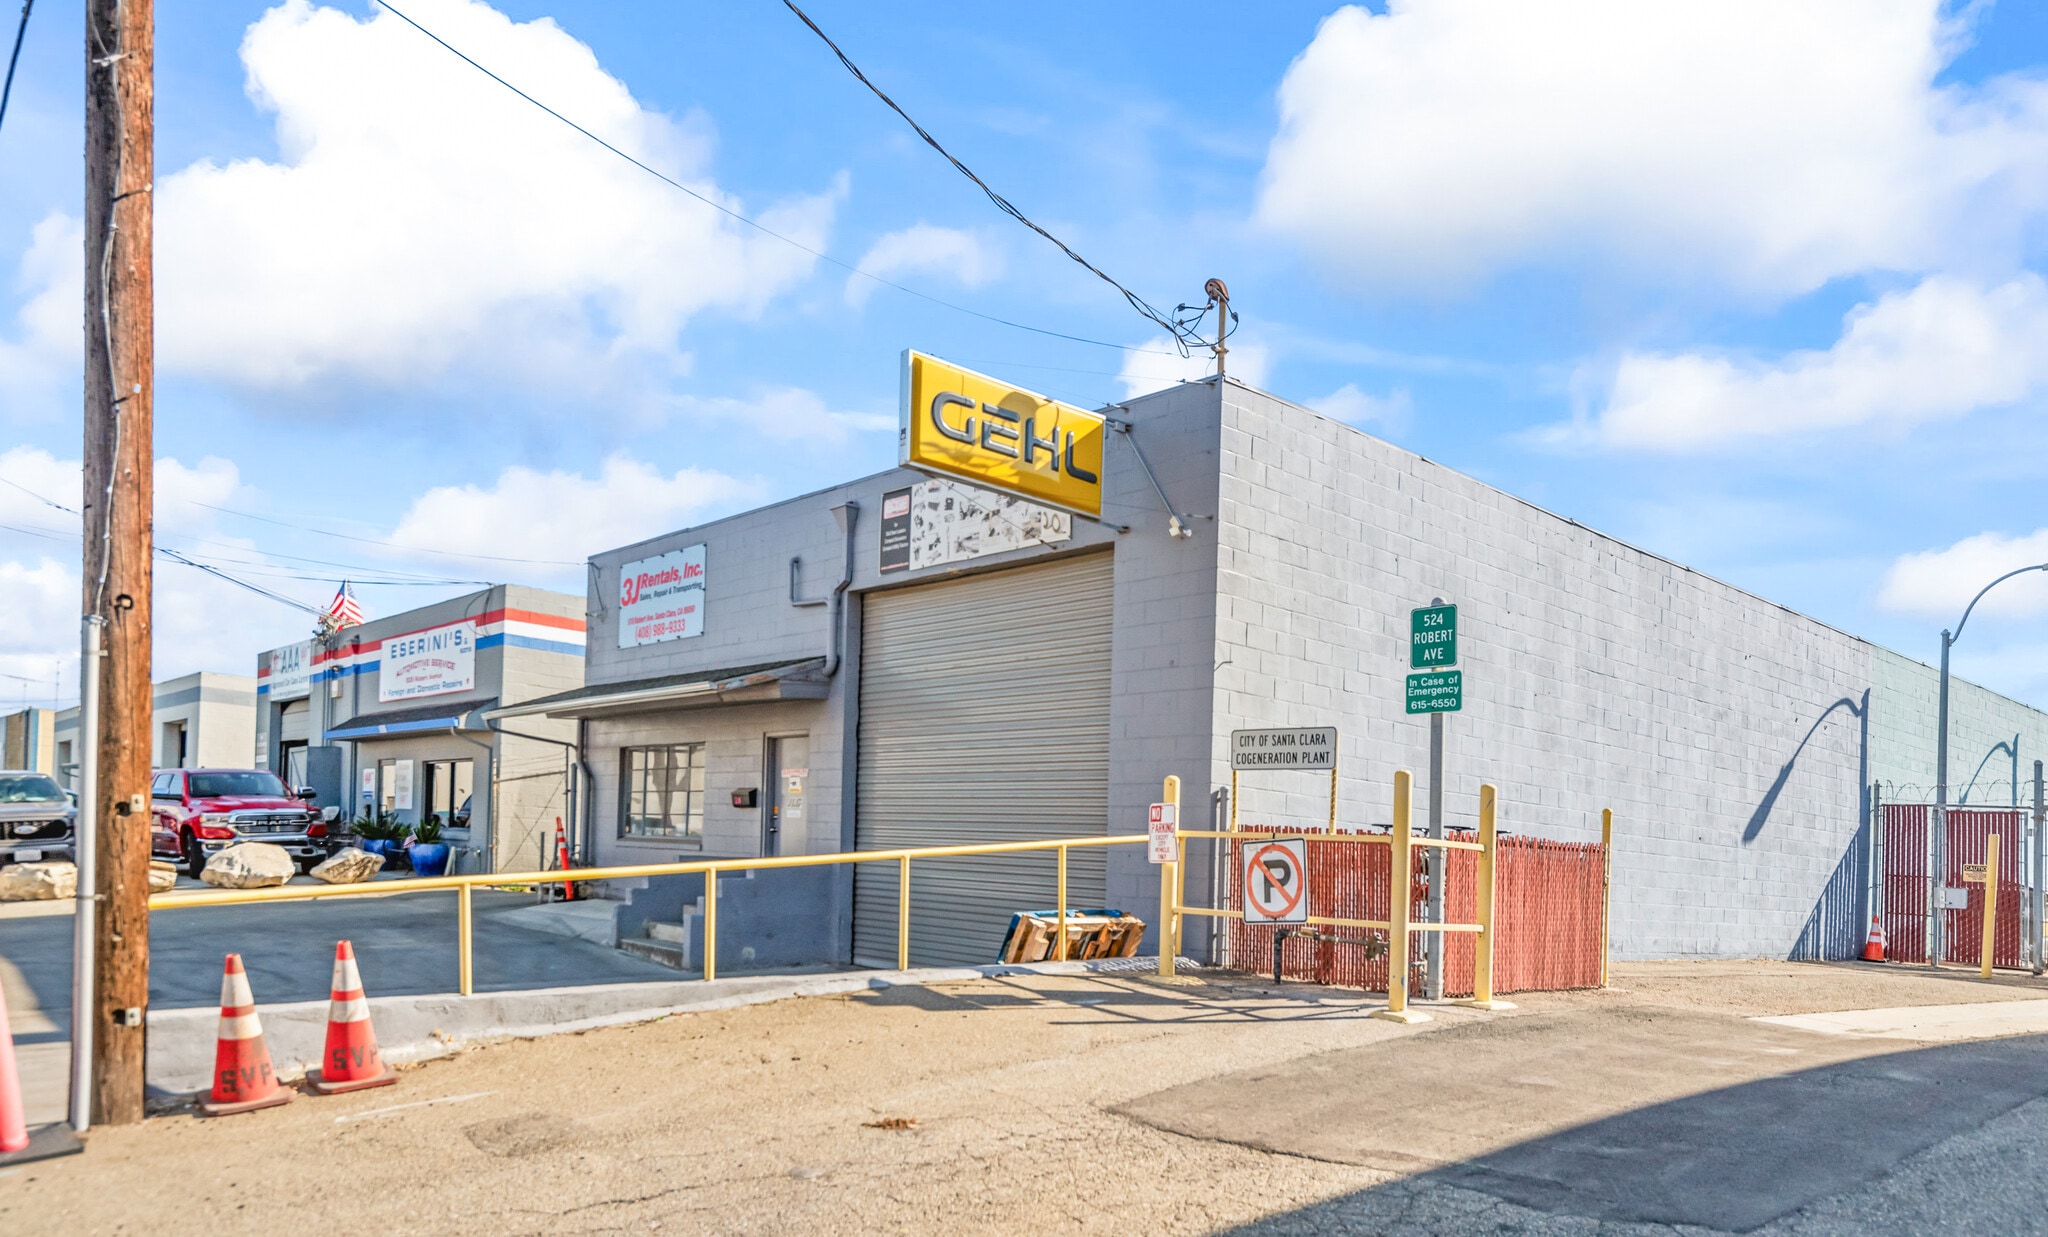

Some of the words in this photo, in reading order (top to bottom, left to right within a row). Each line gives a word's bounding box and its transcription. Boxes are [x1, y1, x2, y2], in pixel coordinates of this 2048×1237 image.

[931, 391, 1098, 485] GEHL
[640, 567, 681, 587] Rentals,
[684, 563, 703, 578] Inc.
[653, 588, 668, 598] Repair
[673, 582, 702, 593] Transporting
[1424, 613, 1443, 626] 524
[635, 623, 651, 641] (408)
[653, 619, 685, 636] 988-9333
[1414, 629, 1453, 644] ROBERT
[391, 629, 462, 659] ESERINI'S
[280, 646, 300, 673] AAA
[1423, 647, 1444, 661] AVE
[396, 659, 430, 677] AUTOMOTIVE
[431, 658, 456, 671] SERVICE
[417, 684, 441, 693] Domestic
[442, 680, 463, 688] Repairs
[1409, 679, 1417, 687] In
[1421, 677, 1444, 686] Case
[1448, 675, 1458, 684] of
[1408, 686, 1459, 696] Emergency
[1411, 698, 1456, 710] 615-6550
[1240, 735, 1256, 747] CITY
[1259, 735, 1268, 746] OF
[1272, 734, 1296, 746] SANTA
[1299, 733, 1327, 746] CLARA
[1236, 752, 1298, 764] COGENERATION
[1302, 751, 1330, 763] PLANT
[1152, 807, 1161, 820] NO
[1151, 822, 1174, 833] PARKING
[333, 1043, 378, 1070] SVP
